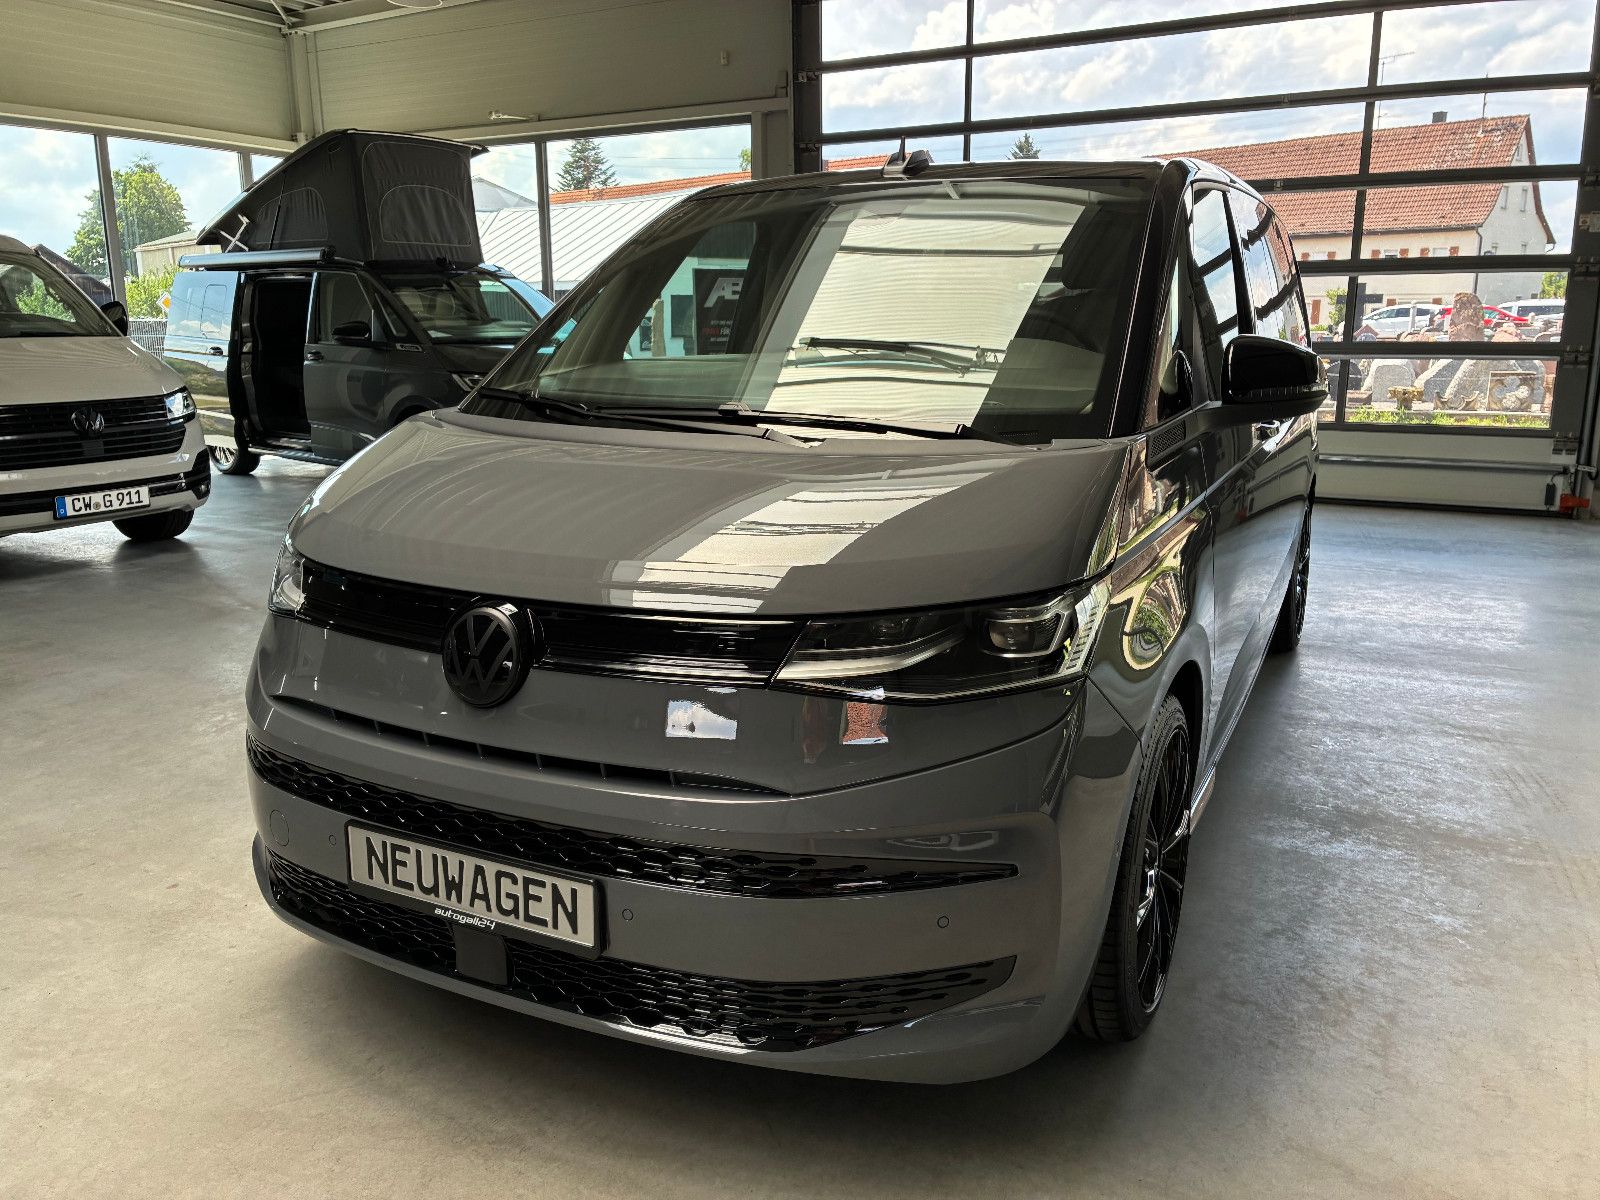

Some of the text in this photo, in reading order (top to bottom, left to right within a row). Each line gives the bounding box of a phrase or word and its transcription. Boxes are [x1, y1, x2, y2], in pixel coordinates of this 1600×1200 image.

[71, 489, 144, 512] CW G 911
[448, 609, 516, 698] VW
[365, 836, 578, 934] NEUWAGEN
[434, 907, 496, 930] autogall24
